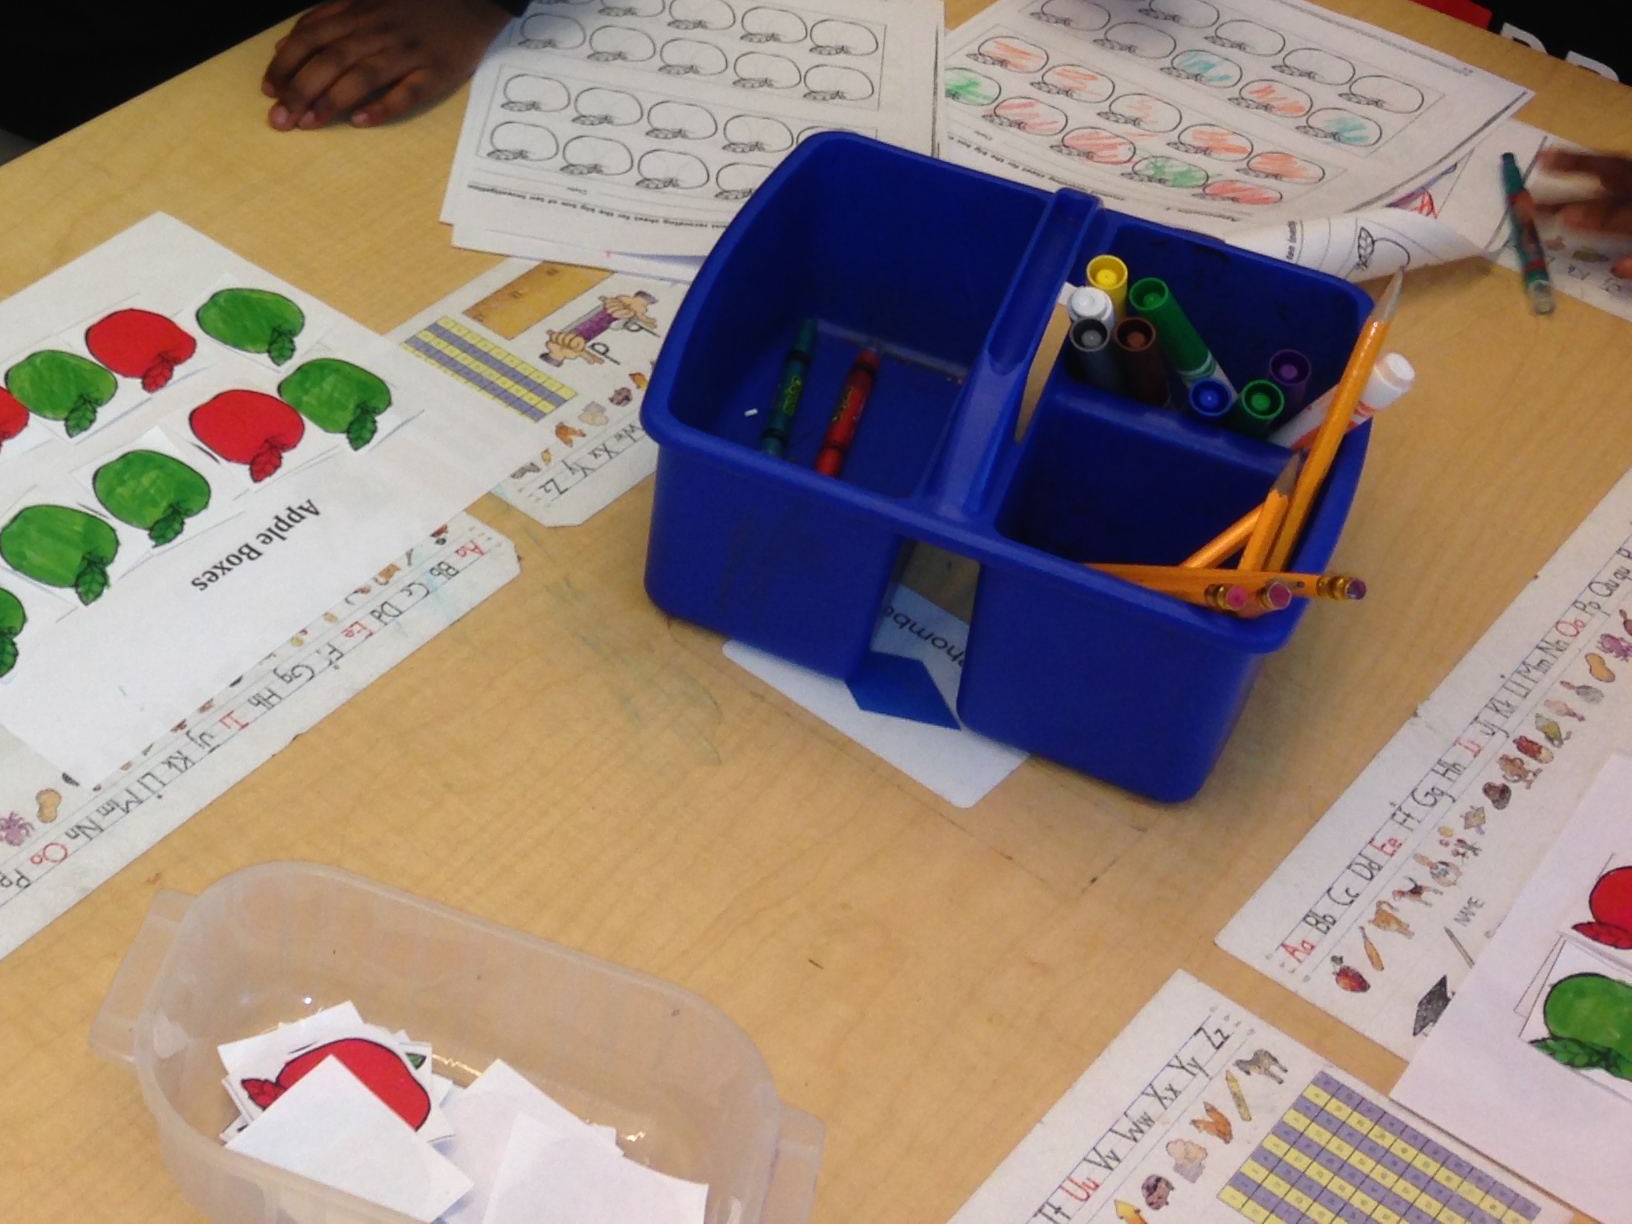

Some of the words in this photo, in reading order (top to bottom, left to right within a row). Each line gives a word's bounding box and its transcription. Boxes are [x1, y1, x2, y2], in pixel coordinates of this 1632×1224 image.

[590, 443, 620, 460] Xx
[560, 458, 597, 478] Yy
[538, 478, 570, 495] Zz
[256, 499, 321, 547] Apple
[454, 539, 486, 559] Aa
[191, 540, 264, 592] Boxes
[429, 560, 460, 581] Bb
[401, 581, 431, 599] Cc
[369, 600, 403, 626] Dd
[1571, 599, 1612, 617] Pp
[341, 620, 374, 639] Ee
[1555, 619, 1586, 638] Oo
[1536, 639, 1570, 659] Nn
[272, 663, 316, 686] Gg
[1516, 661, 1552, 684] Mm
[247, 687, 283, 710] Hh
[1485, 696, 1516, 720] Kk
[1474, 715, 1510, 739] Jj
[161, 750, 196, 774] Kk
[1430, 757, 1467, 783] Hh
[1410, 785, 1456, 808] Gg
[65, 815, 105, 841] Nn
[30, 842, 68, 865] Oo
[1368, 836, 1404, 858] Ee
[1346, 853, 1384, 882] Dd
[1326, 886, 1360, 906] Cc
[1302, 909, 1337, 935] Bb
[1280, 938, 1317, 964] Aa
[1059, 1175, 1101, 1202] Uu
[1082, 1146, 1122, 1171] Vv
[1109, 1111, 1156, 1143] Ww
[1141, 1082, 1182, 1110] Xx
[1166, 1054, 1214, 1081] Yy
[1193, 1026, 1231, 1051] Zz
